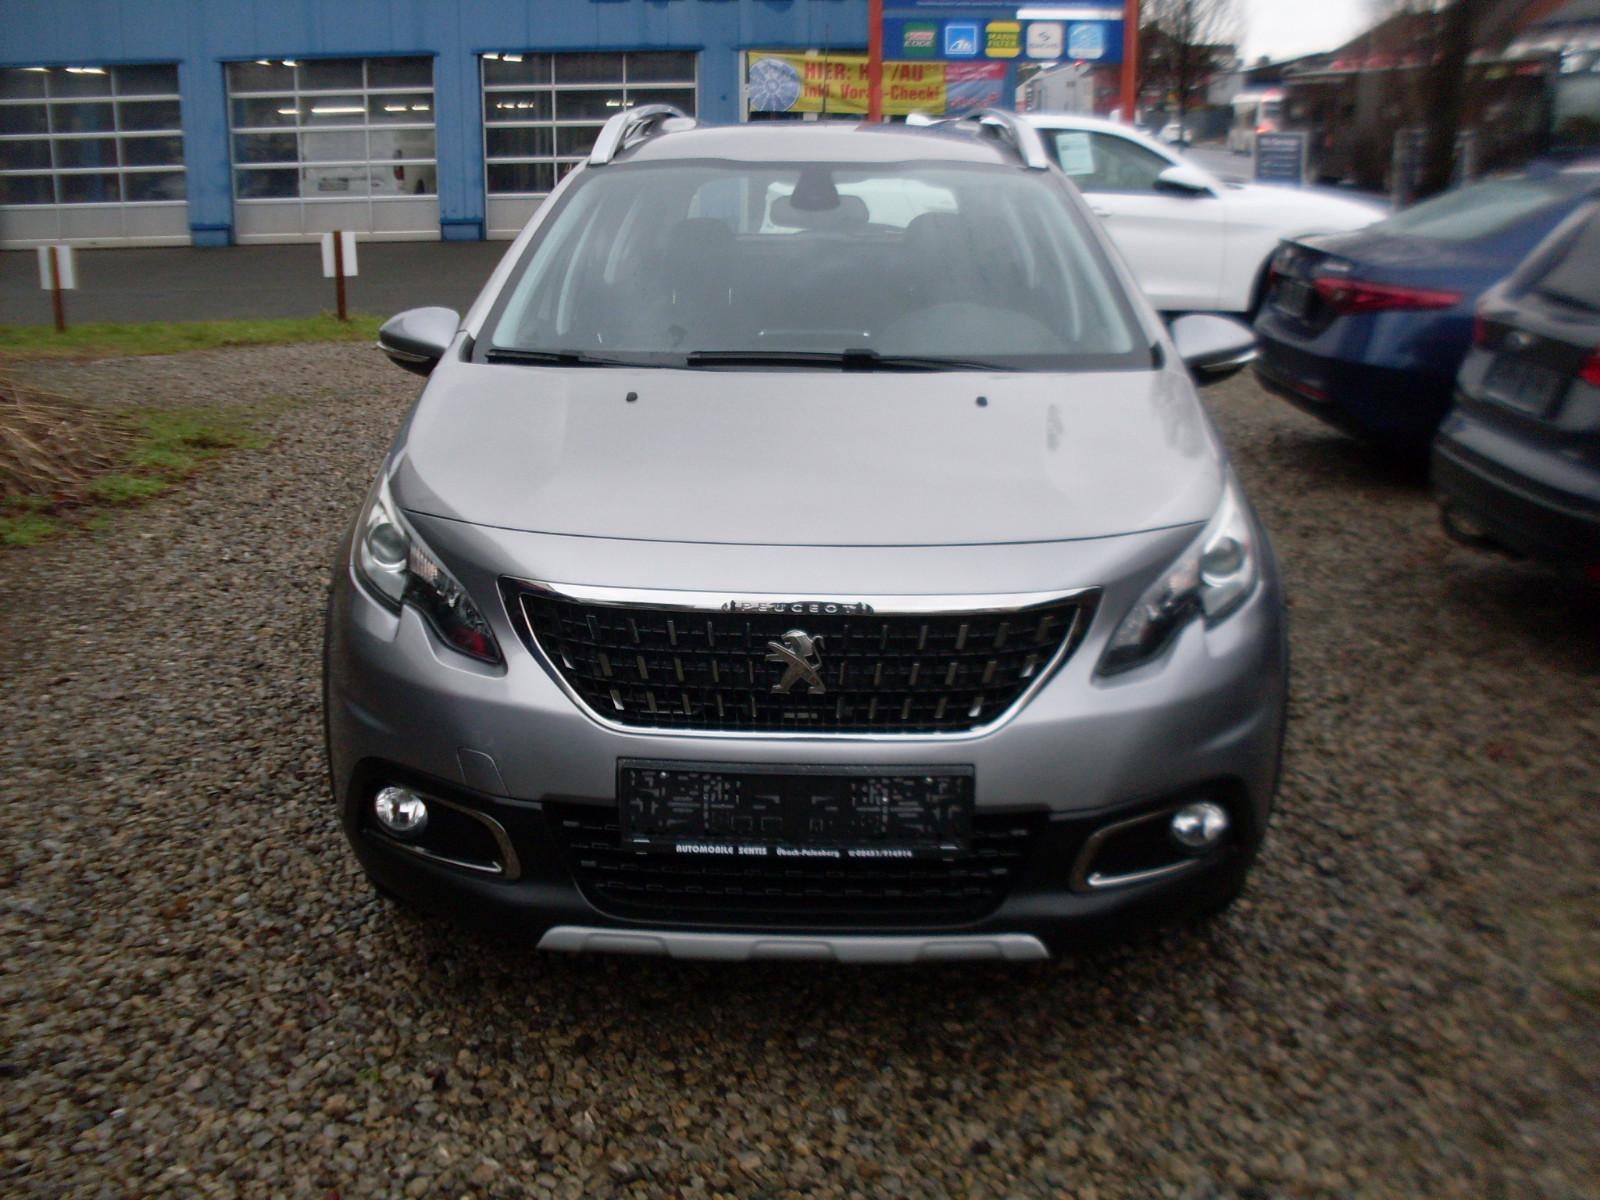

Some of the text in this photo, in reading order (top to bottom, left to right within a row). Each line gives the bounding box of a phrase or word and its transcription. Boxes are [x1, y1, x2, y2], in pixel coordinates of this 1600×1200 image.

[805, 62, 851, 81] HIER:
[740, 602, 857, 614] PEUGEOT
[676, 845, 734, 855] AUTOMOBILE
